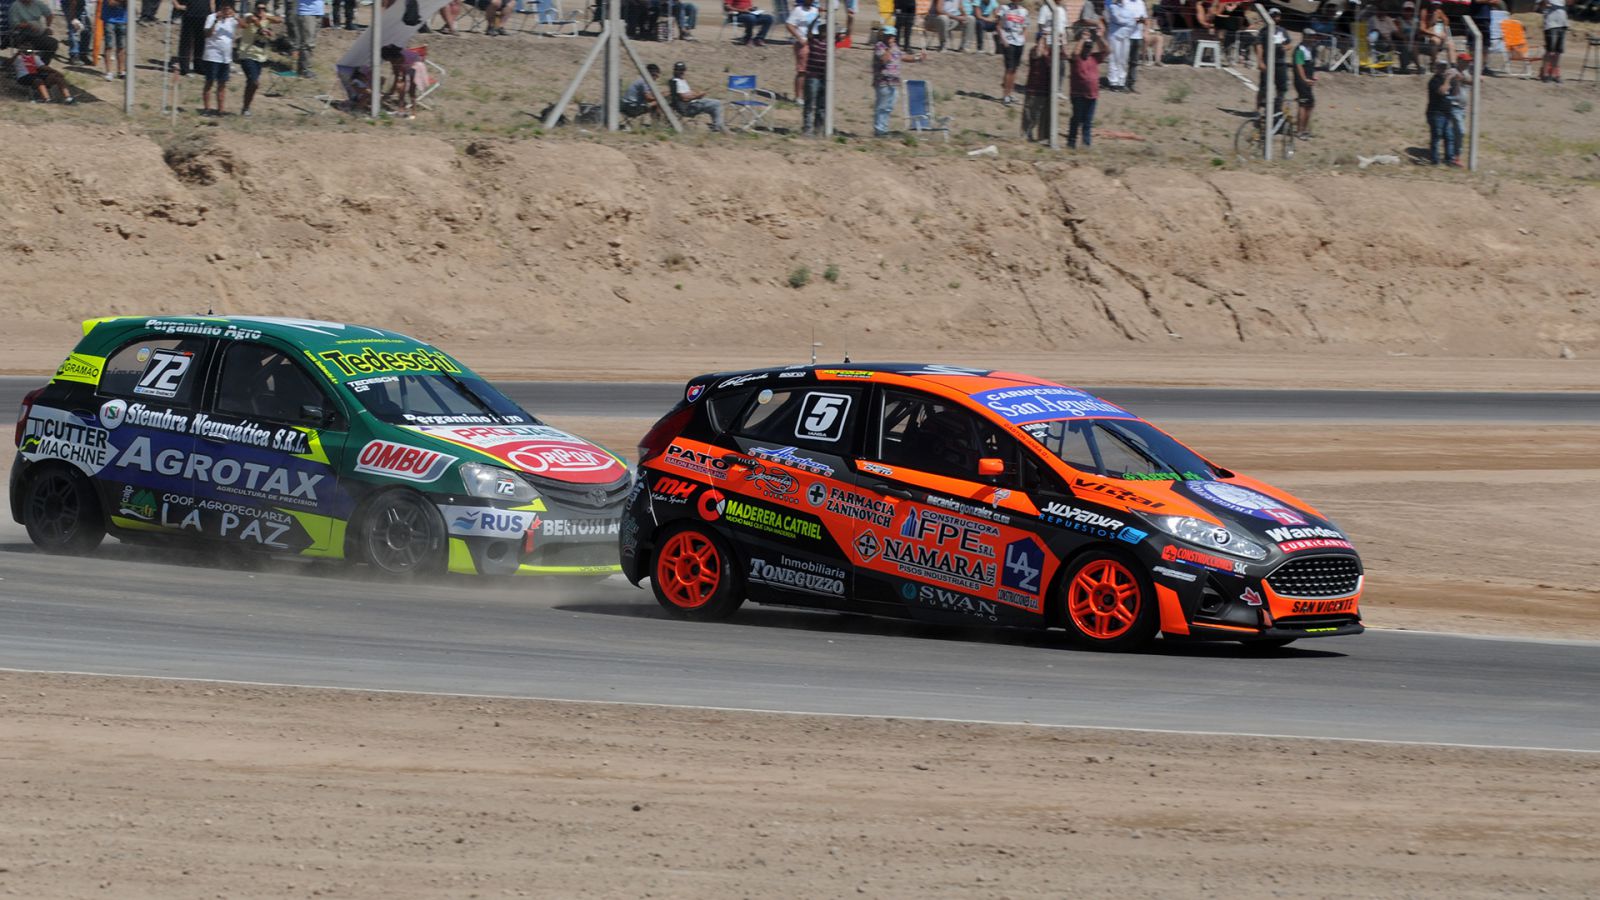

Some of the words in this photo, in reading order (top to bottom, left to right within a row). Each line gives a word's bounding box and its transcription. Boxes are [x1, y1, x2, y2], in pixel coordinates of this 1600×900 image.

[145, 319, 222, 335] Pergamino
[224, 325, 262, 340] Agro
[140, 353, 191, 390] 72
[318, 347, 462, 376] Tedeschi
[347, 376, 400, 387] TEDESCHI
[403, 414, 489, 425] Pergamino
[804, 397, 844, 432] 5
[987, 400, 1042, 417] San
[44, 418, 108, 449] CUTTER
[125, 403, 188, 432] Siembra
[189, 413, 271, 447] Neumática
[272, 428, 306, 454] S.R.L.
[38, 439, 106, 466] MACHINE
[360, 442, 439, 474] OMBU
[668, 446, 728, 470] PATO
[115, 436, 325, 500] AGROTAX
[216, 485, 266, 499] AGRICULTURA
[653, 476, 698, 498] MH
[198, 500, 292, 524] AGROPECUARIA
[826, 500, 891, 528] ZANINOVICH
[830, 488, 895, 516] FARMACIA
[161, 502, 203, 532] LA
[220, 512, 290, 549] PAZ
[480, 512, 524, 532] RUS
[543, 520, 605, 536] BERTOSSI
[726, 500, 782, 528] MADERERA
[783, 516, 822, 540] CATRIEL
[921, 510, 1000, 537] CONSTRUCTORA
[1038, 512, 1116, 540] REPUESTOS
[917, 518, 981, 553] FPE
[781, 555, 846, 579] Inmobiliaria
[883, 538, 985, 582] NAMARA
[1006, 544, 1040, 592] LAZ
[750, 558, 845, 594] TONEGUZZO
[899, 564, 922, 576] PISOS
[923, 571, 980, 590] INDUSTRIALES
[920, 585, 998, 614] SWAN
[920, 595, 998, 622] TURISMO
[1292, 601, 1314, 612] SAN
[1316, 598, 1354, 612] VICENTE
